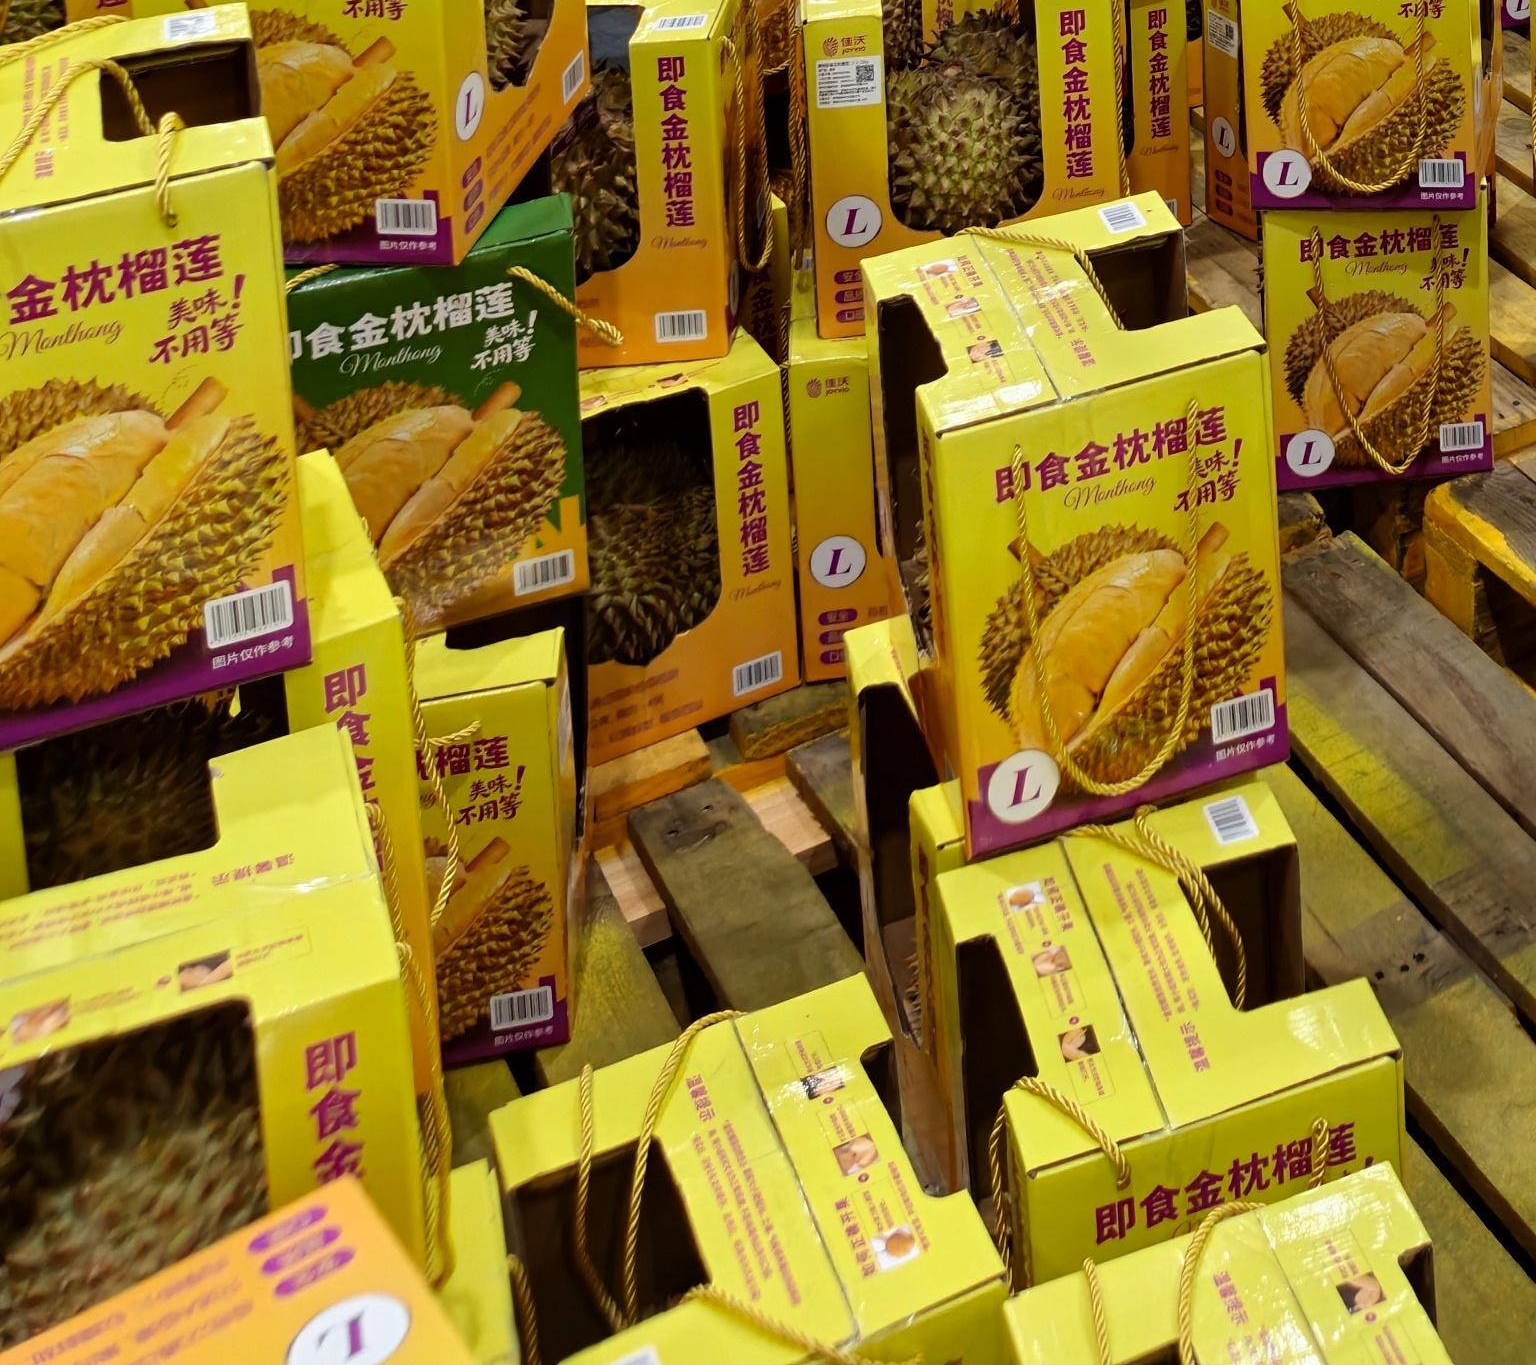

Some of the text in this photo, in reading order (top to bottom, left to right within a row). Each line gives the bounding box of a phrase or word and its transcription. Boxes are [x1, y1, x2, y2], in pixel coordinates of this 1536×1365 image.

[1147, 8, 1171, 140] 即食金枕榴莲
[462, 92, 479, 122] L
[1059, 9, 1095, 179] 即食金枕榴莲
[656, 56, 695, 228] 即食金枕榴莲
[1275, 158, 1302, 191] L
[840, 207, 868, 237] L
[379, 238, 438, 253] 图片仅作参考
[1299, 224, 1460, 262] 即食金枕榴莲
[0, 234, 223, 325] 金枕榴莲
[168, 273, 248, 329] 美味!
[149, 319, 245, 365] 不用等
[470, 338, 537, 372] 不用等
[994, 405, 1228, 505] 即食金枕榴莲
[1297, 440, 1325, 468] L
[731, 398, 771, 578] 即食金枕榴莲
[824, 547, 852, 577] L
[211, 634, 295, 670] 图片仅作参考
[1214, 732, 1276, 763] 图片仅作参考
[1009, 767, 1042, 806] L
[457, 795, 523, 827] 不用等
